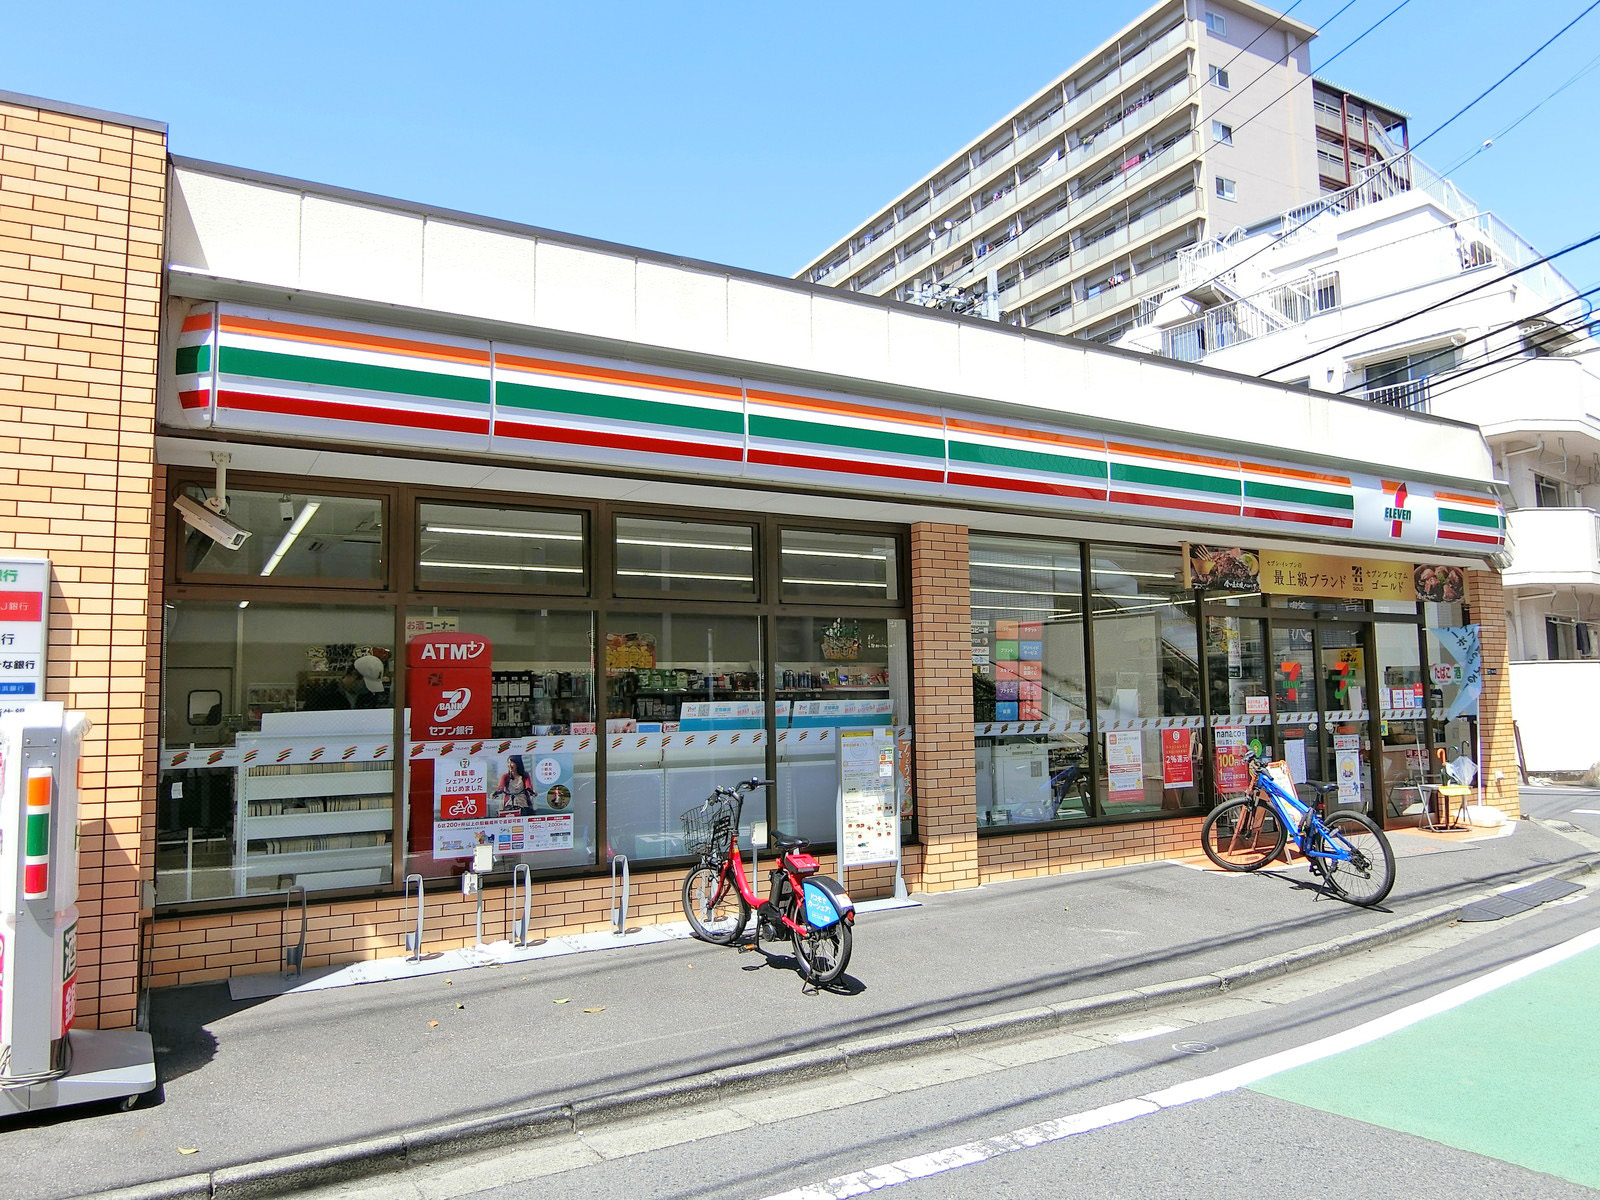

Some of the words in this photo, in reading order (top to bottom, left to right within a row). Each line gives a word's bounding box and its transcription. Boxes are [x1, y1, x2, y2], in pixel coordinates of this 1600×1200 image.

[1273, 569, 1346, 589] 最上級ブランド
[1366, 569, 1408, 580] セブンプレミアム
[1372, 580, 1404, 592] ゴールド
[1434, 666, 1452, 680] たばこ
[428, 726, 474, 736] セブン銀行
[1166, 754, 1189, 764] 2%還元
[454, 769, 475, 777] 自転車
